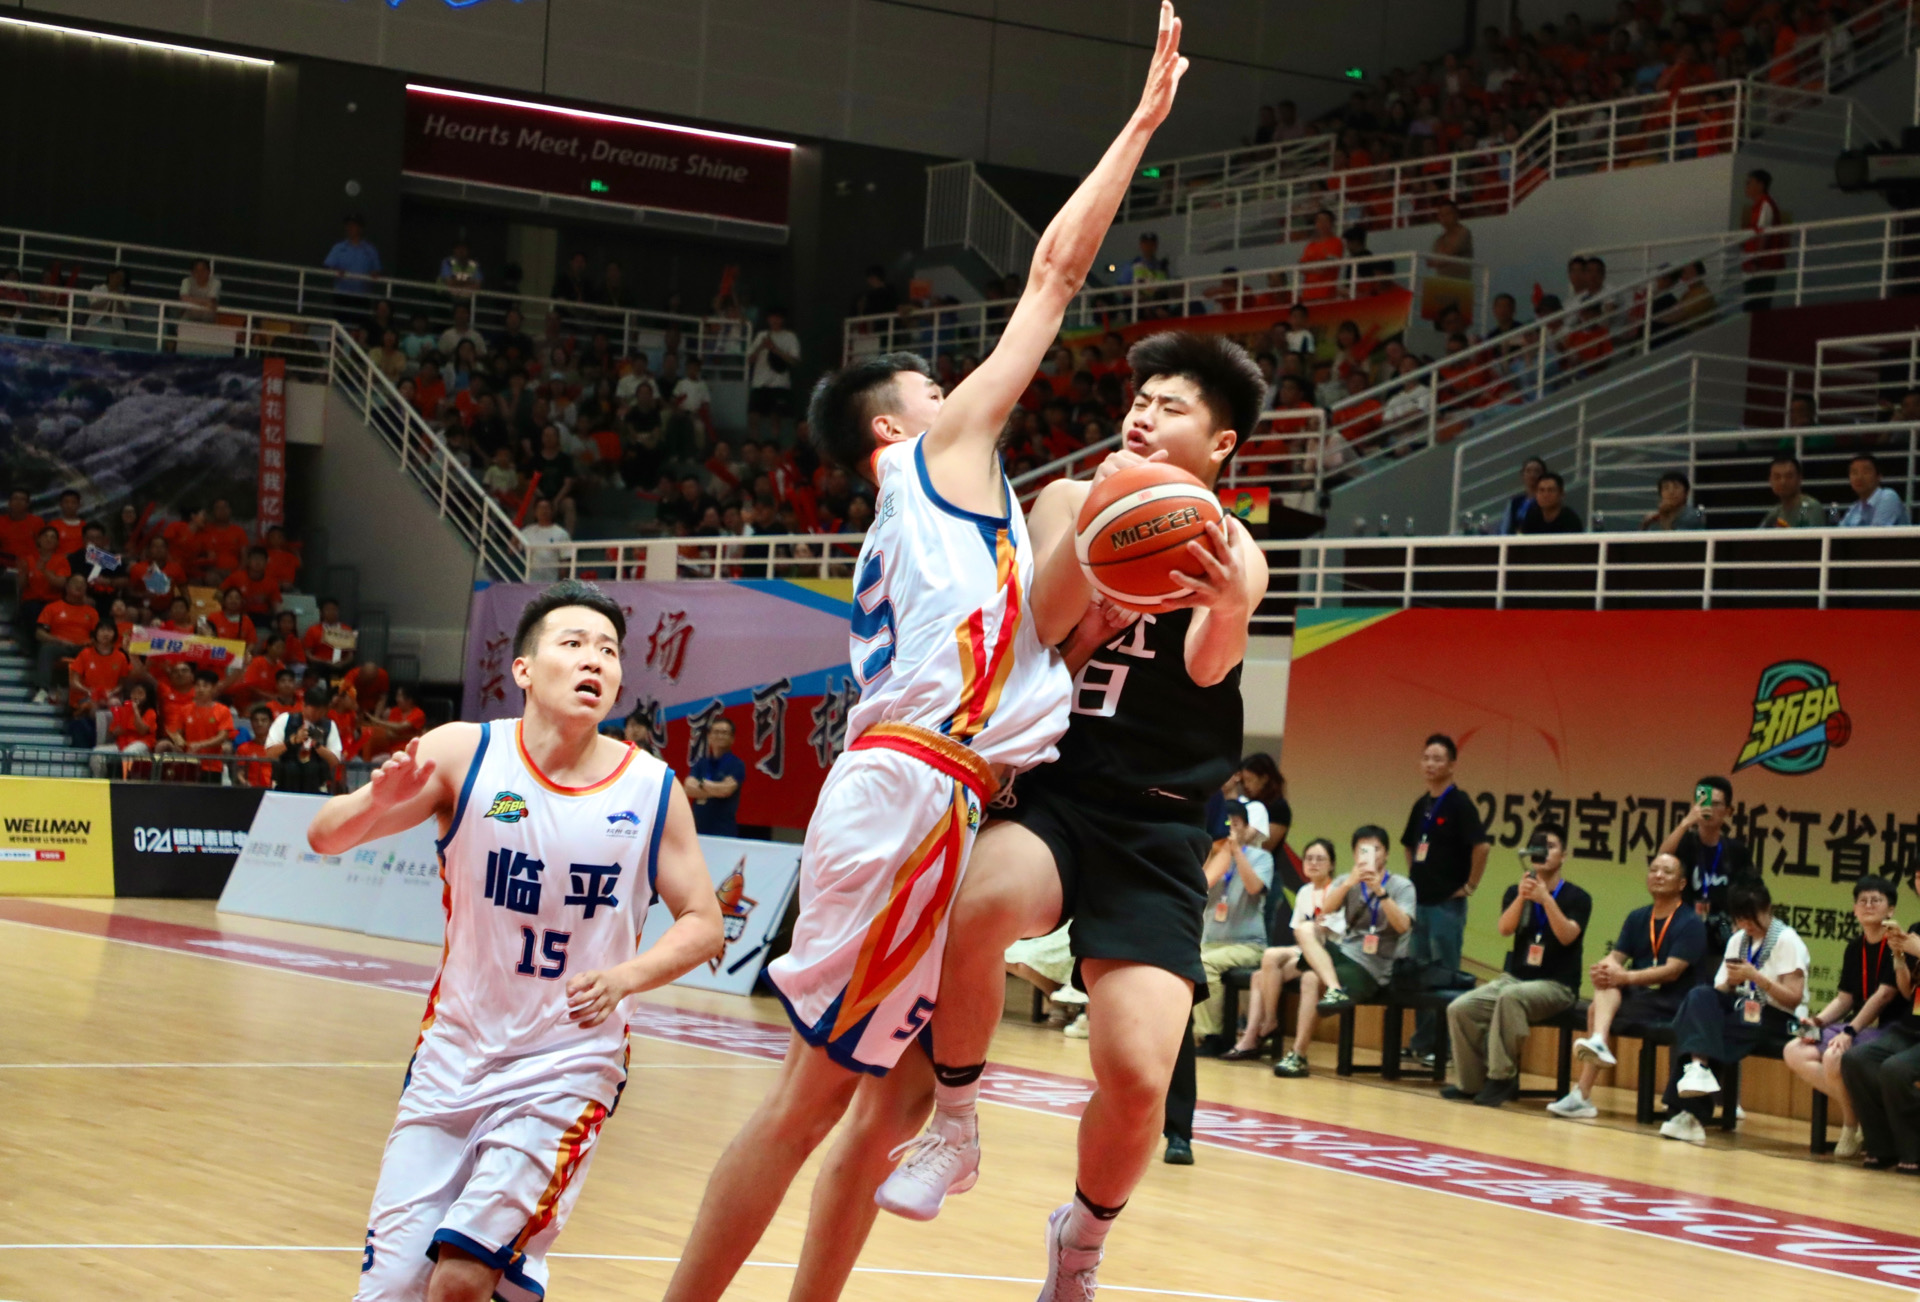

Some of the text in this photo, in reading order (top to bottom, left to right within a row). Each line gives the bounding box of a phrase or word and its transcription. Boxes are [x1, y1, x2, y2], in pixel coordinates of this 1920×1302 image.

[423, 113, 749, 184] Hearts Meet, Dreams Shine
[4, 817, 92, 835] WELLMAN
[484, 847, 623, 920] 临平
[515, 925, 572, 981] 15
[890, 994, 936, 1042] 5
